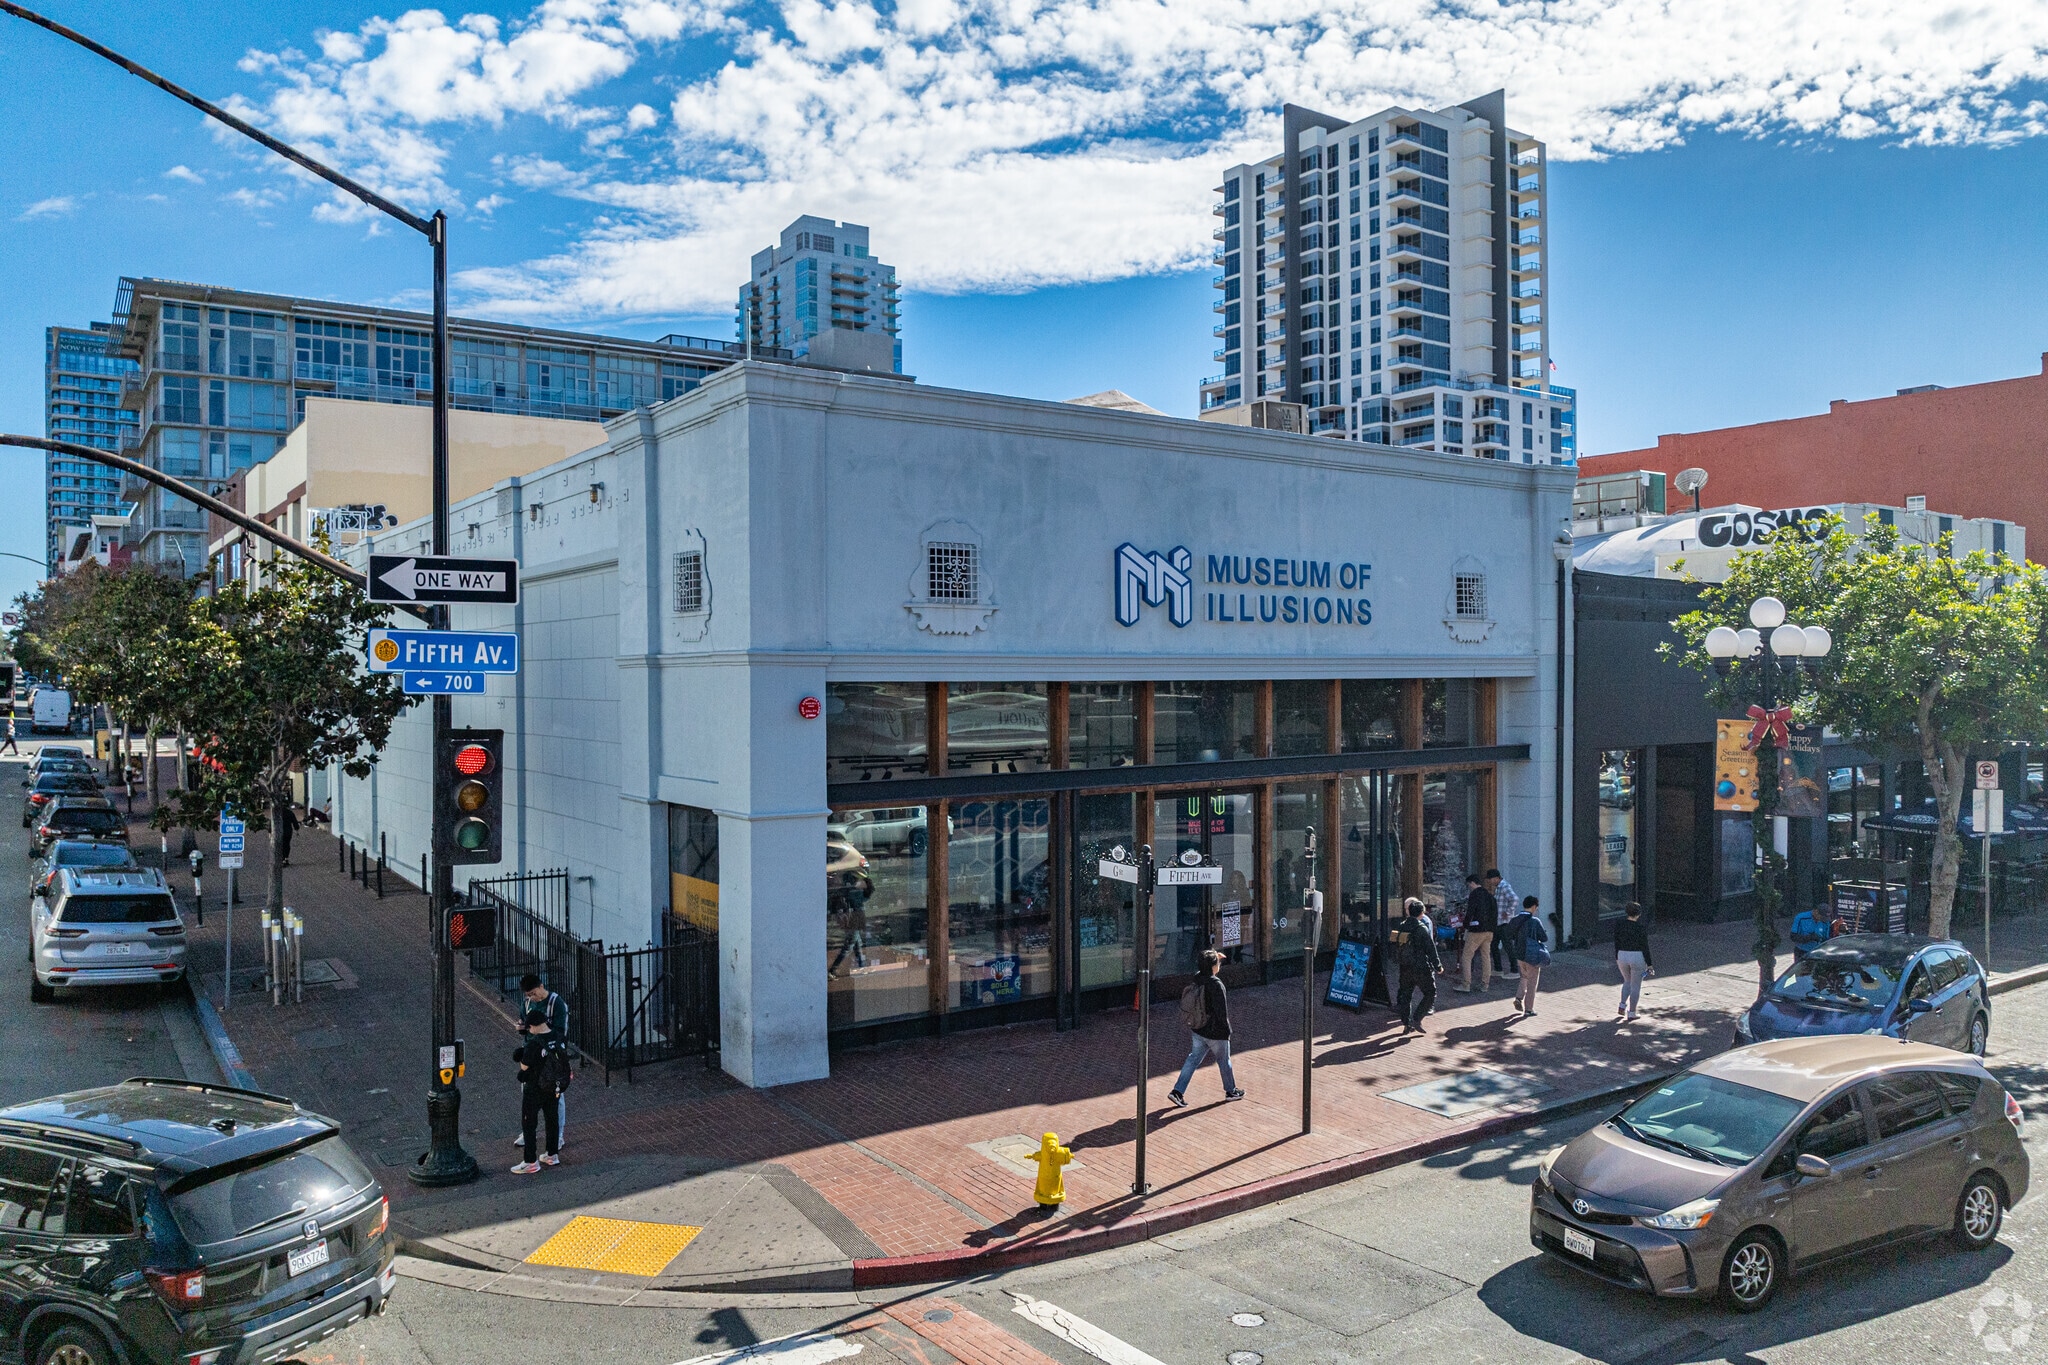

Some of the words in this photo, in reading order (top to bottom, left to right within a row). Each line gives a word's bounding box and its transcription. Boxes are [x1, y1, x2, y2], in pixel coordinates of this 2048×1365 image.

[1207, 554, 1331, 588] MUSEUM
[1338, 562, 1372, 590] OF
[415, 572, 451, 588] ONE
[459, 573, 495, 589] WAY
[1207, 592, 1372, 625] ILLUSIONS
[405, 639, 464, 664] FIFTH
[444, 675, 473, 690] 700
[1606, 842, 1624, 850] LEASE
[1112, 865, 1119, 877] G
[1169, 870, 1199, 882] FIFTH
[990, 981, 1009, 989] SOLD
[996, 987, 1015, 996] HERE
[1330, 991, 1343, 1000] NOW
[1343, 994, 1358, 1003] OPEN
